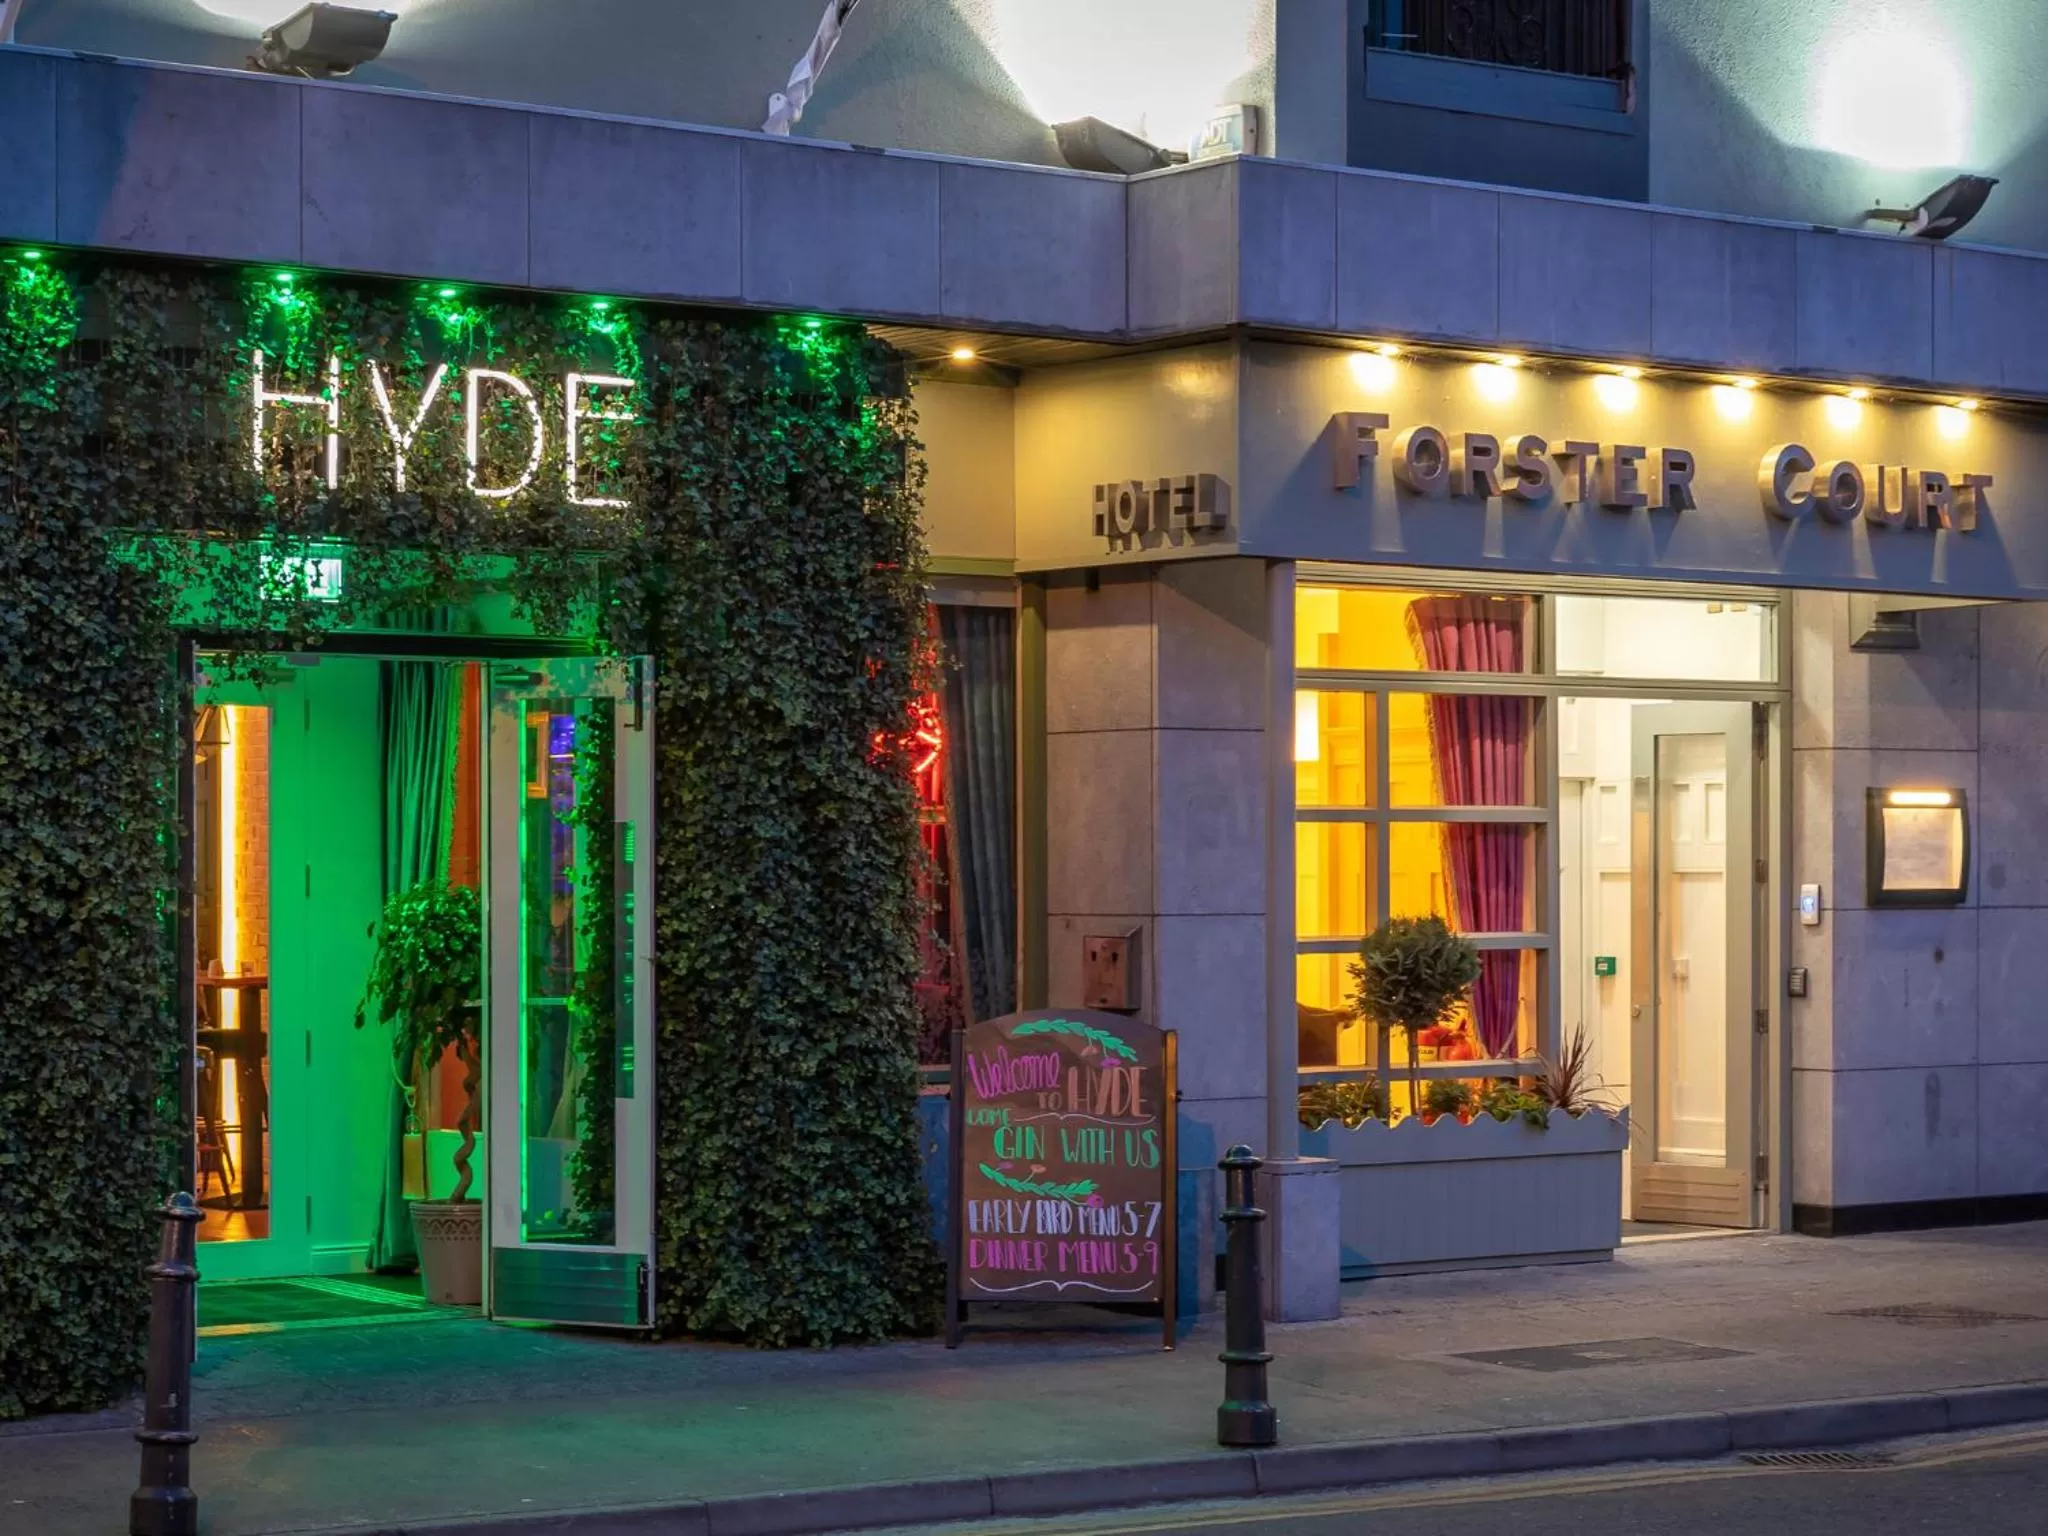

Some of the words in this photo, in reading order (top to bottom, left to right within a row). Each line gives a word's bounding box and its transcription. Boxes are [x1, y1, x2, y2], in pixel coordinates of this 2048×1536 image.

[252, 349, 638, 507] HYDE
[1333, 411, 1697, 512] FORSTER
[1758, 443, 1993, 531] COURT
[1092, 473, 1230, 538] HOTEL
[967, 1045, 1060, 1099] Welcome
[1067, 1065, 1152, 1117] HYDE
[993, 1126, 1045, 1161] GIN
[1060, 1128, 1115, 1165] WITH
[1124, 1128, 1160, 1168] US
[968, 1199, 1031, 1234] EARLY
[1036, 1199, 1073, 1235] BIRD
[1078, 1205, 1120, 1236] MENU
[1121, 1200, 1162, 1238] 5-7
[968, 1238, 1049, 1273] DINNER
[1058, 1240, 1117, 1275] MENU
[1120, 1241, 1158, 1276] 5-9
